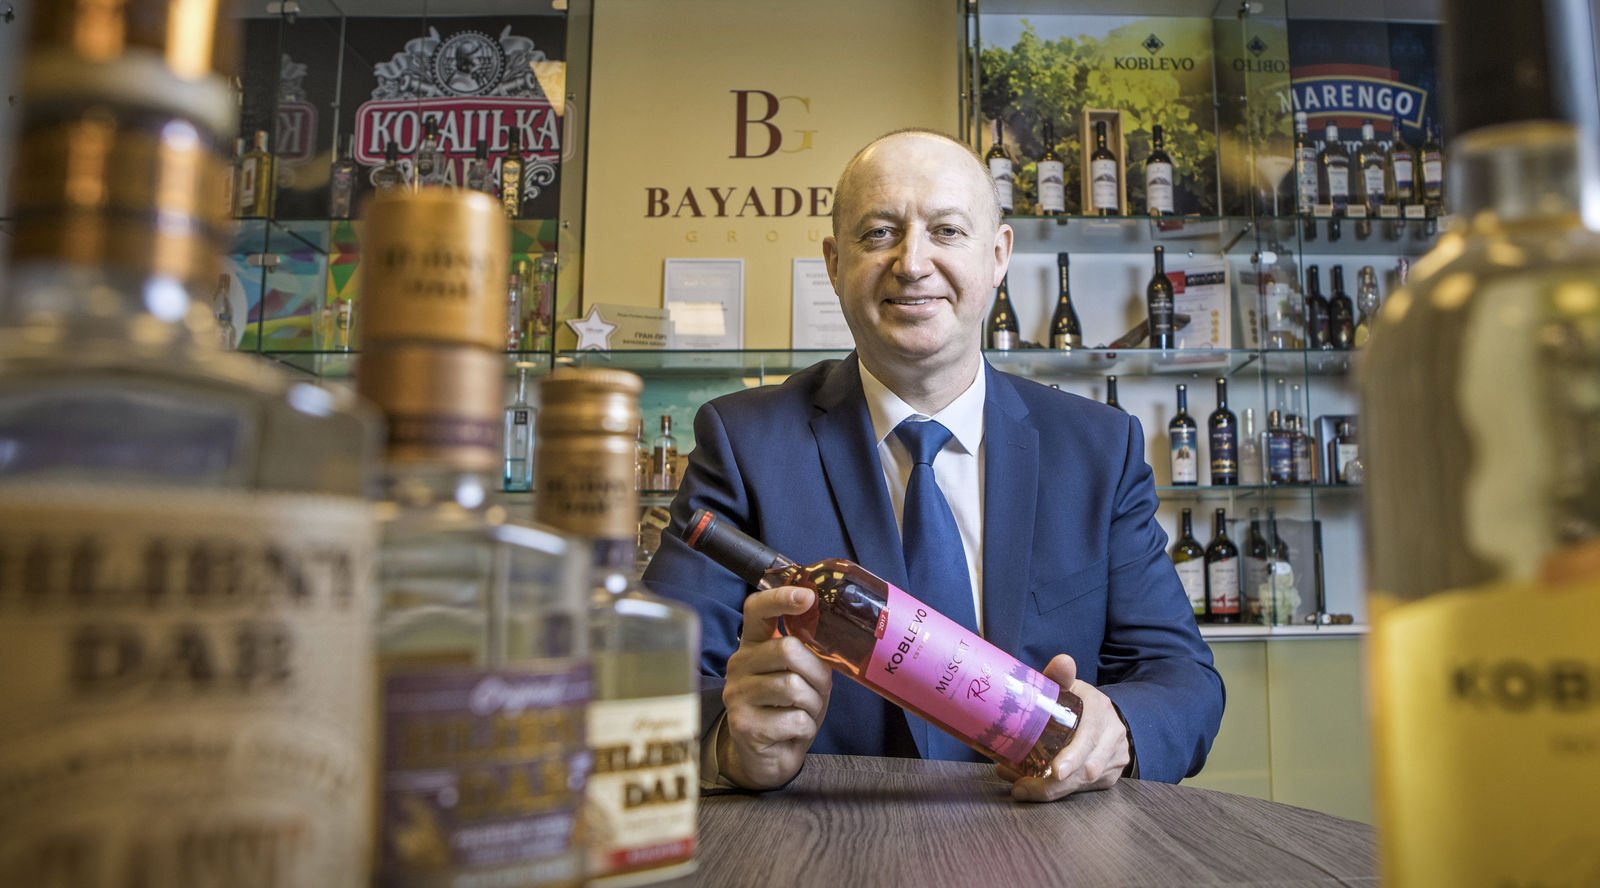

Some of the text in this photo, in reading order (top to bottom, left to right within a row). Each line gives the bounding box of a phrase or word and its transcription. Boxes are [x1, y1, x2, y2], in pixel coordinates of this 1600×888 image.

[1113, 56, 1195, 72] KOBLEVO
[1276, 83, 1414, 116] MARENGO
[728, 89, 819, 159] BG
[644, 186, 834, 218] BAYADE
[685, 230, 822, 243] GROU
[884, 608, 927, 675] KOBLEVO
[1449, 658, 1600, 713] KOB
